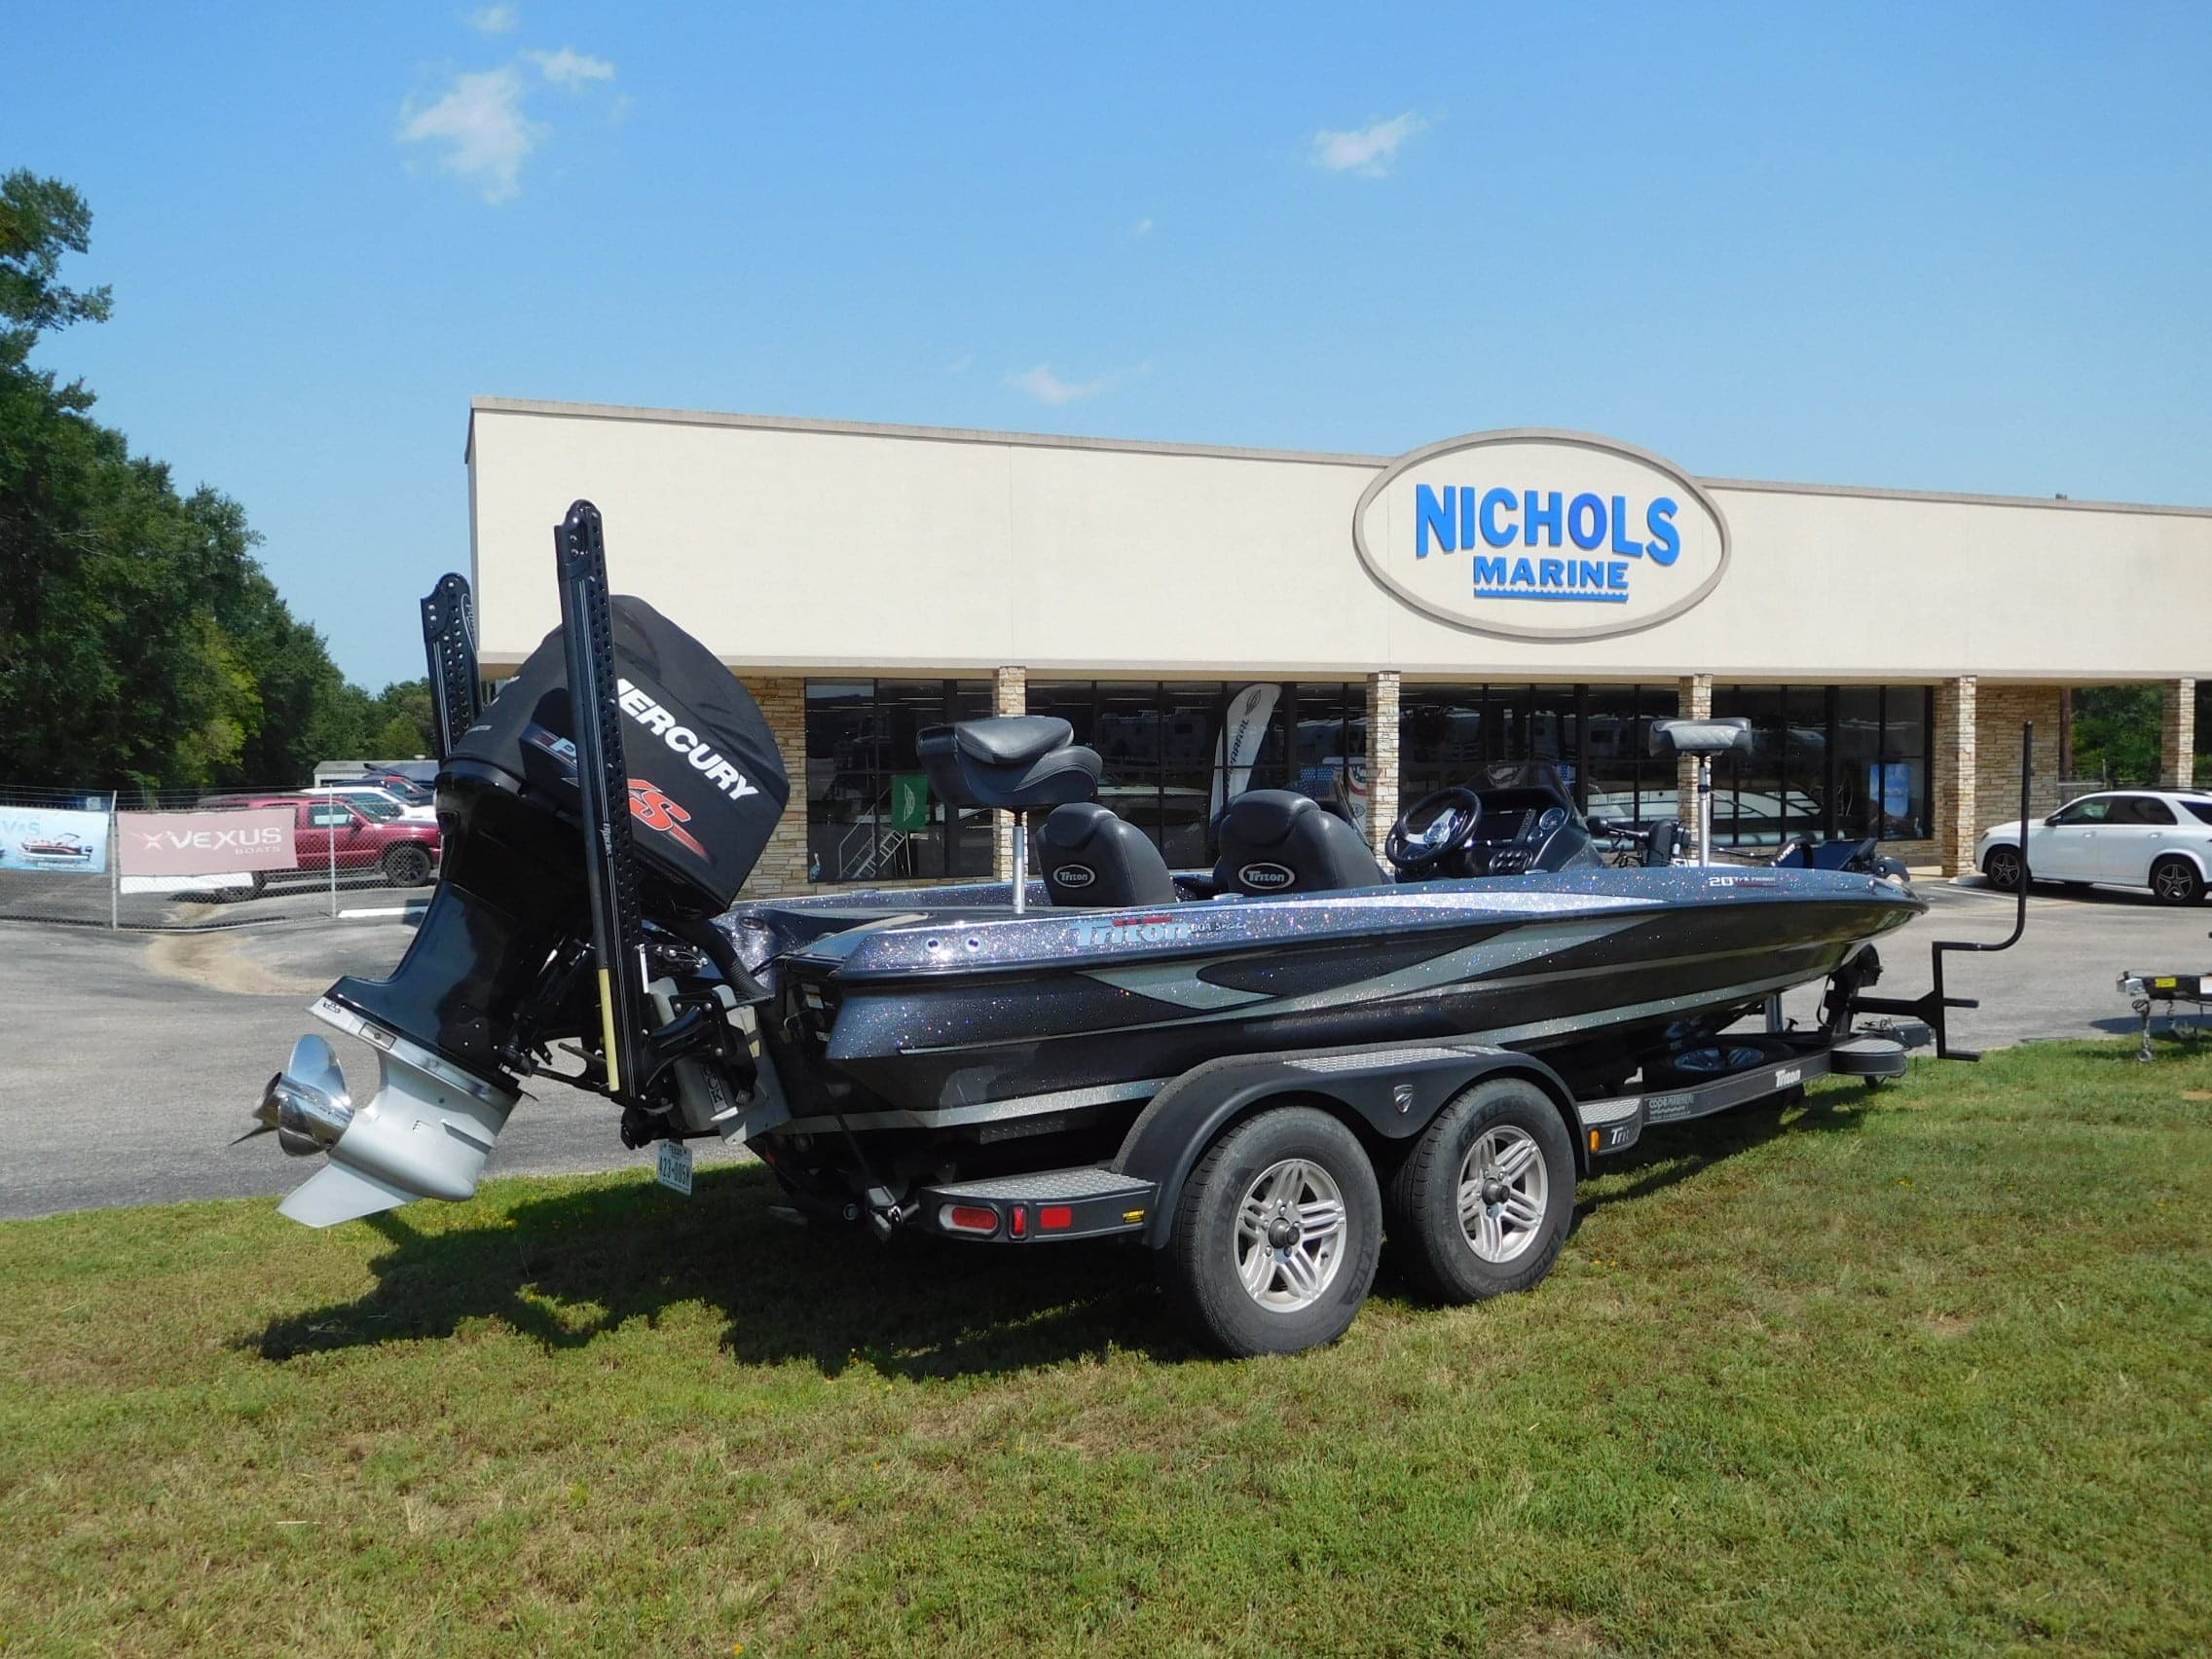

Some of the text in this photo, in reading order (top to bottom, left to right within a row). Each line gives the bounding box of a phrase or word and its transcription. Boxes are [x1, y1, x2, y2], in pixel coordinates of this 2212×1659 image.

[1416, 483, 1681, 567] NICHOLS
[1472, 555, 1630, 590] MARINE
[617, 678, 759, 801] ERCURY
[166, 827, 282, 850] VEXUS
[235, 846, 281, 856] BOATS
[1059, 871, 1088, 881] Triton
[1246, 870, 1285, 882] Triton
[1069, 919, 1190, 947] Triton
[1775, 1068, 1801, 1088] Triton
